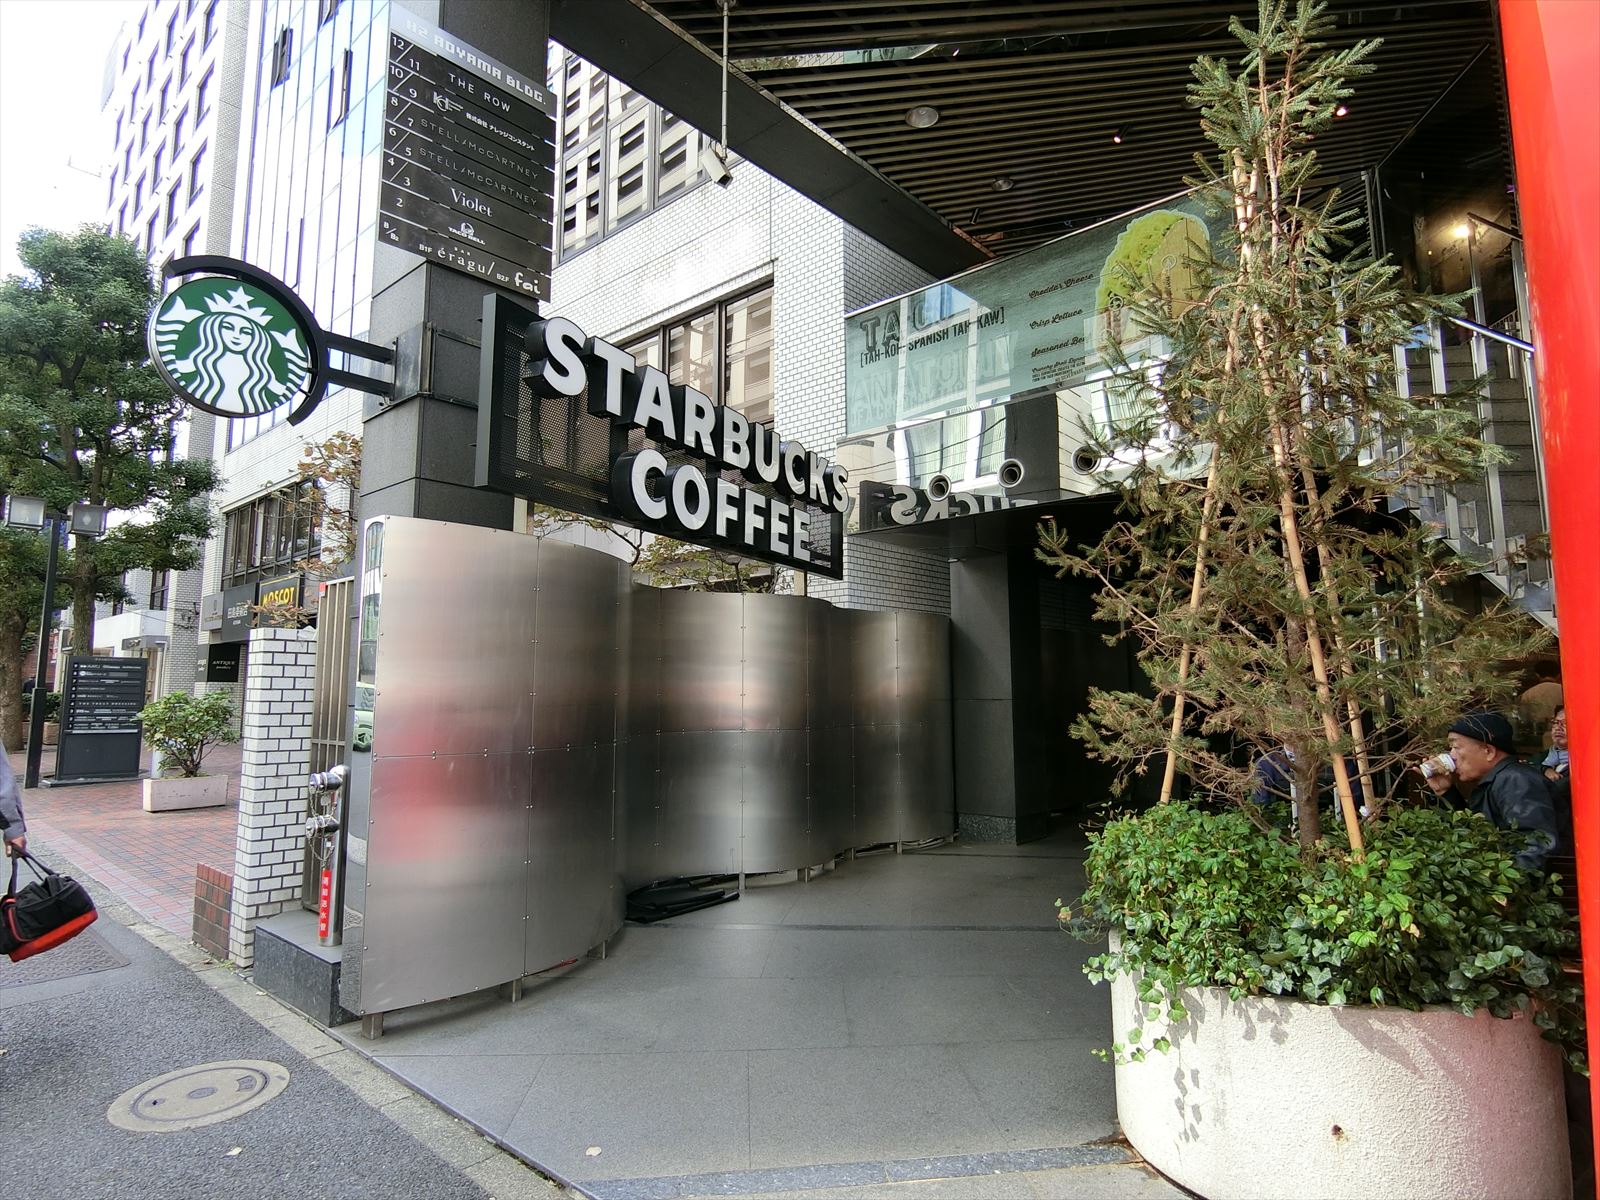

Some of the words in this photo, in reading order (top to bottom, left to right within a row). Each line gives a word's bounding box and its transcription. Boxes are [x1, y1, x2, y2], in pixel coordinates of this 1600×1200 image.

[392, 36, 405, 51] 12
[389, 64, 404, 79] 10
[408, 58, 420, 71] 11
[434, 34, 502, 80] AOYAMA
[506, 74, 547, 105] BLDG.
[391, 96, 398, 106] 8
[409, 88, 417, 98] 9
[448, 72, 475, 94] THE
[484, 91, 512, 113] ROW
[389, 127, 397, 137] 6
[407, 117, 414, 127] 7
[387, 157, 395, 166] 4
[404, 147, 412, 156] 5
[403, 176, 411, 187] 3
[396, 197, 404, 208] 2
[450, 187, 493, 218] Violet
[447, 226, 467, 238] TACO
[467, 234, 486, 246] BELL
[514, 271, 541, 294] fai
[1028, 282, 1063, 299] Cheddar
[1063, 273, 1094, 288] Cheese
[1029, 319, 1050, 330] Crisp
[1051, 308, 1083, 324] Lettuce
[908, 330, 949, 351] SPANISH
[1030, 338, 1070, 358] Seasoned
[543, 316, 849, 513] STARBUCKS
[631, 449, 812, 562] COFFEE
[262, 586, 295, 607] MOSCOT
